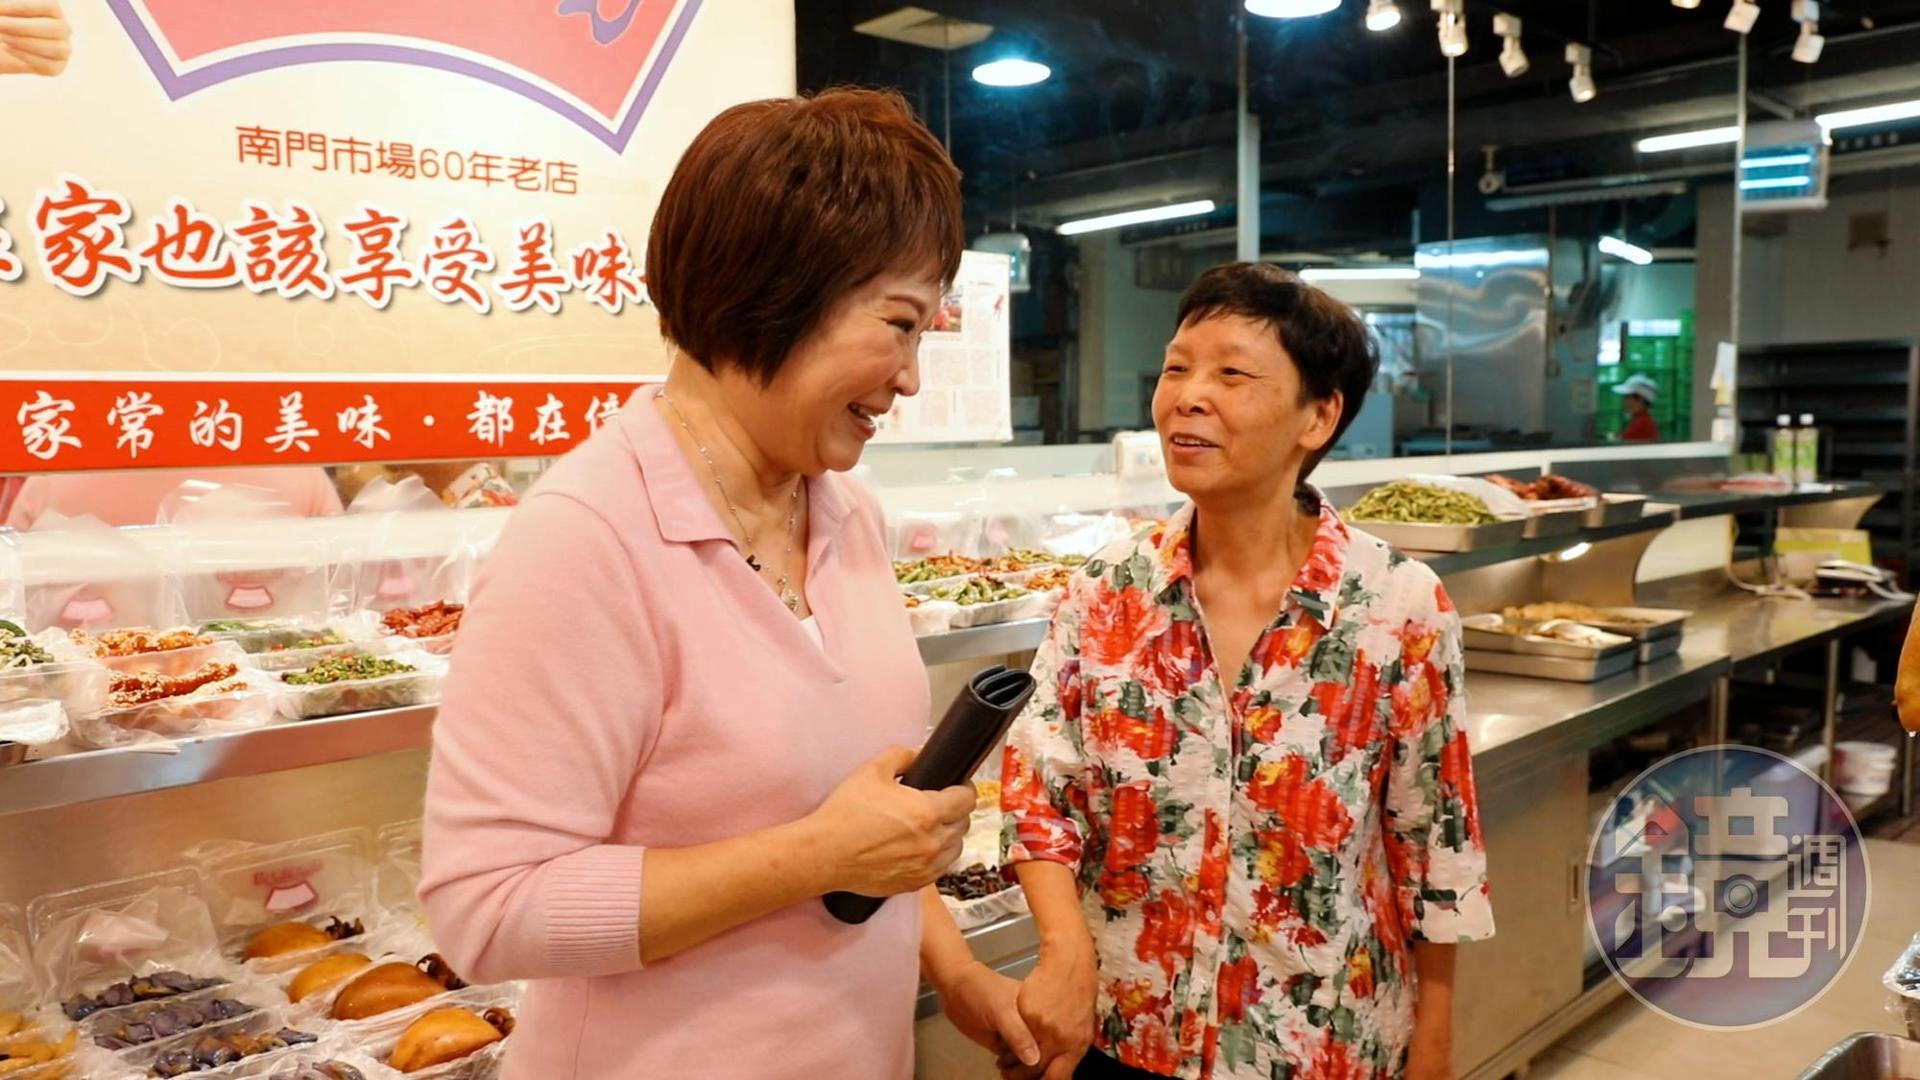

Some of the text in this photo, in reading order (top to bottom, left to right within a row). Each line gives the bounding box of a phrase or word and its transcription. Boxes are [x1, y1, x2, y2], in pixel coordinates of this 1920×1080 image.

[235, 125, 579, 195] 南門市場60年老店
[0, 181, 650, 307] 家也該享受美味
